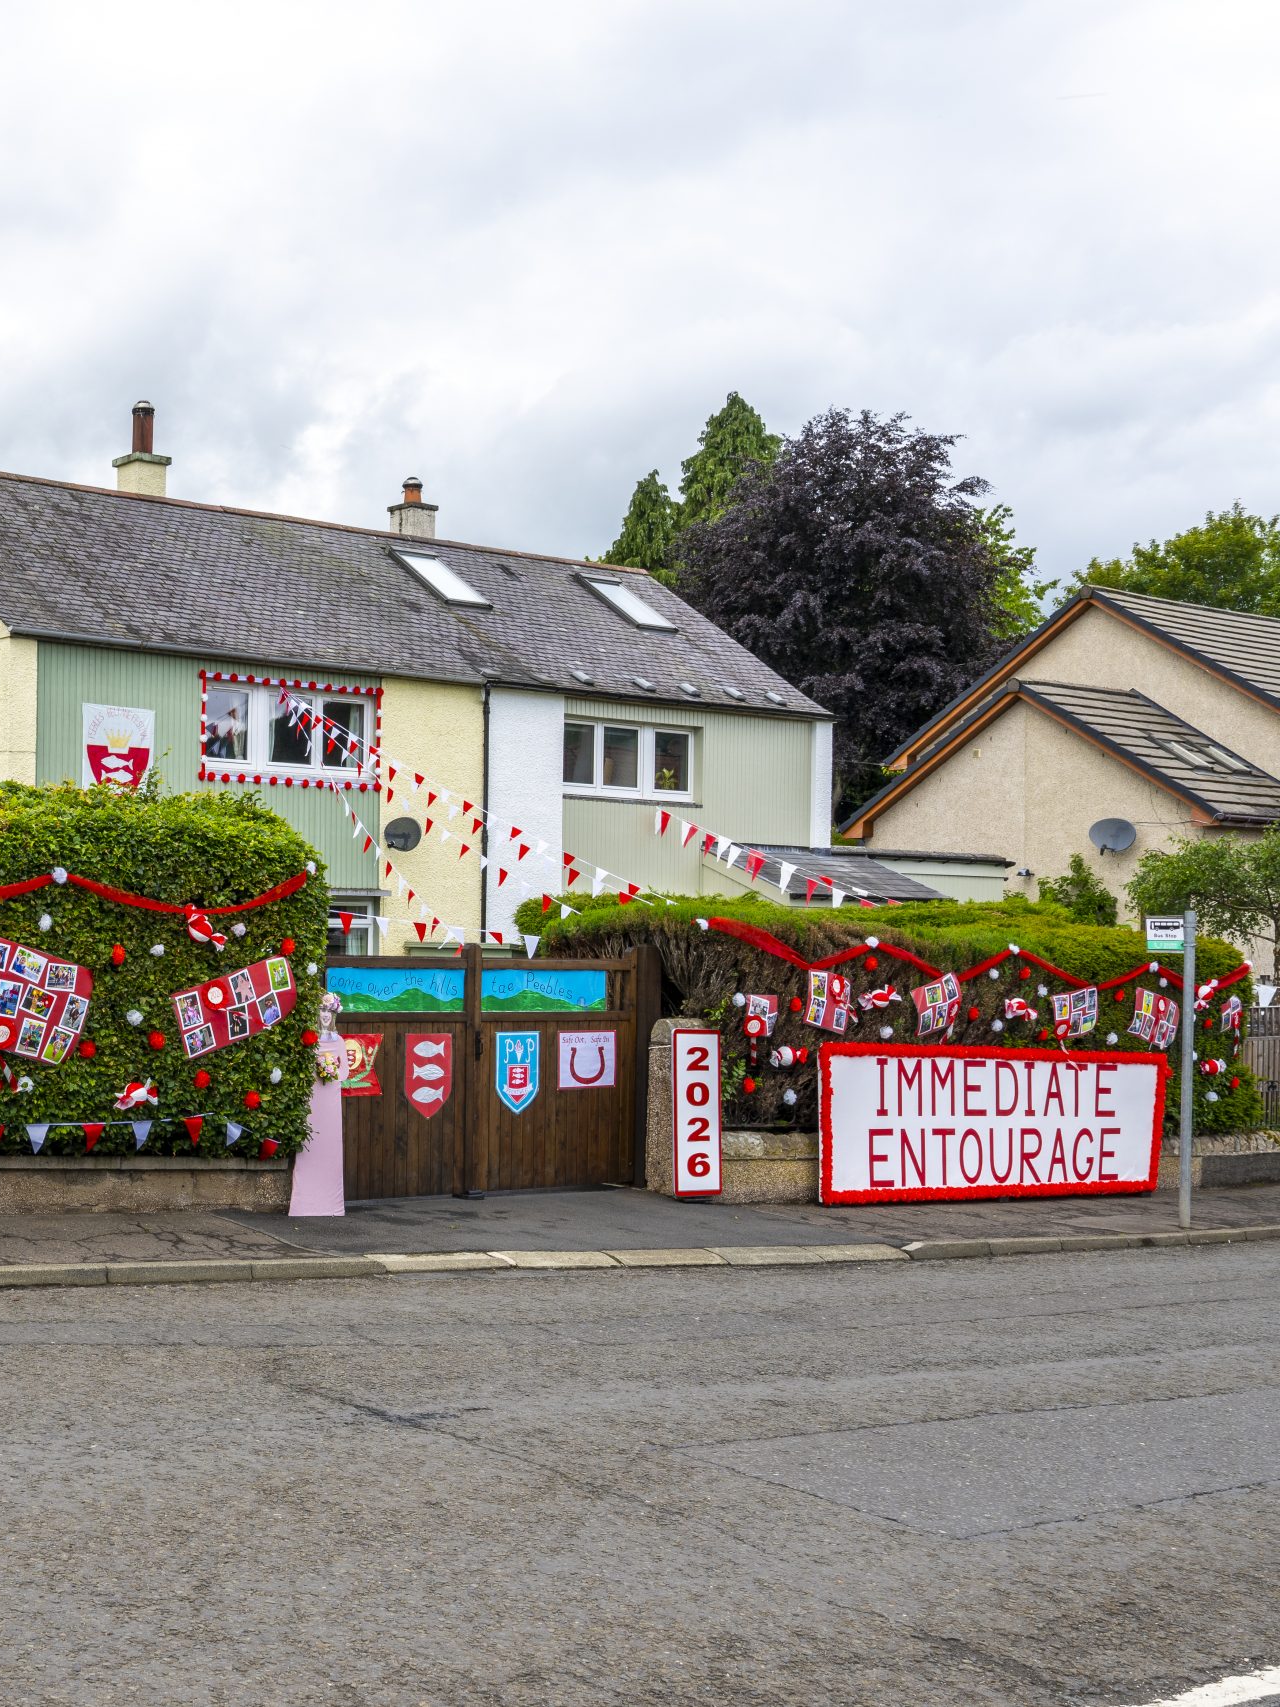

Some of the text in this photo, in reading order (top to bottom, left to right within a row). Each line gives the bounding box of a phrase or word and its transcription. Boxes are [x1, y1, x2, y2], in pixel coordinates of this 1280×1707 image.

[404, 971, 423, 986] the
[429, 971, 458, 996] hills
[491, 971, 572, 1000] tae Peebles
[562, 1034, 573, 1046] Safe
[591, 1034, 601, 1046] Safe
[876, 1058, 1118, 1117] IMMEDIATE
[686, 1046, 710, 1177] 2026
[869, 1128, 1121, 1187] ENTOURAGE
